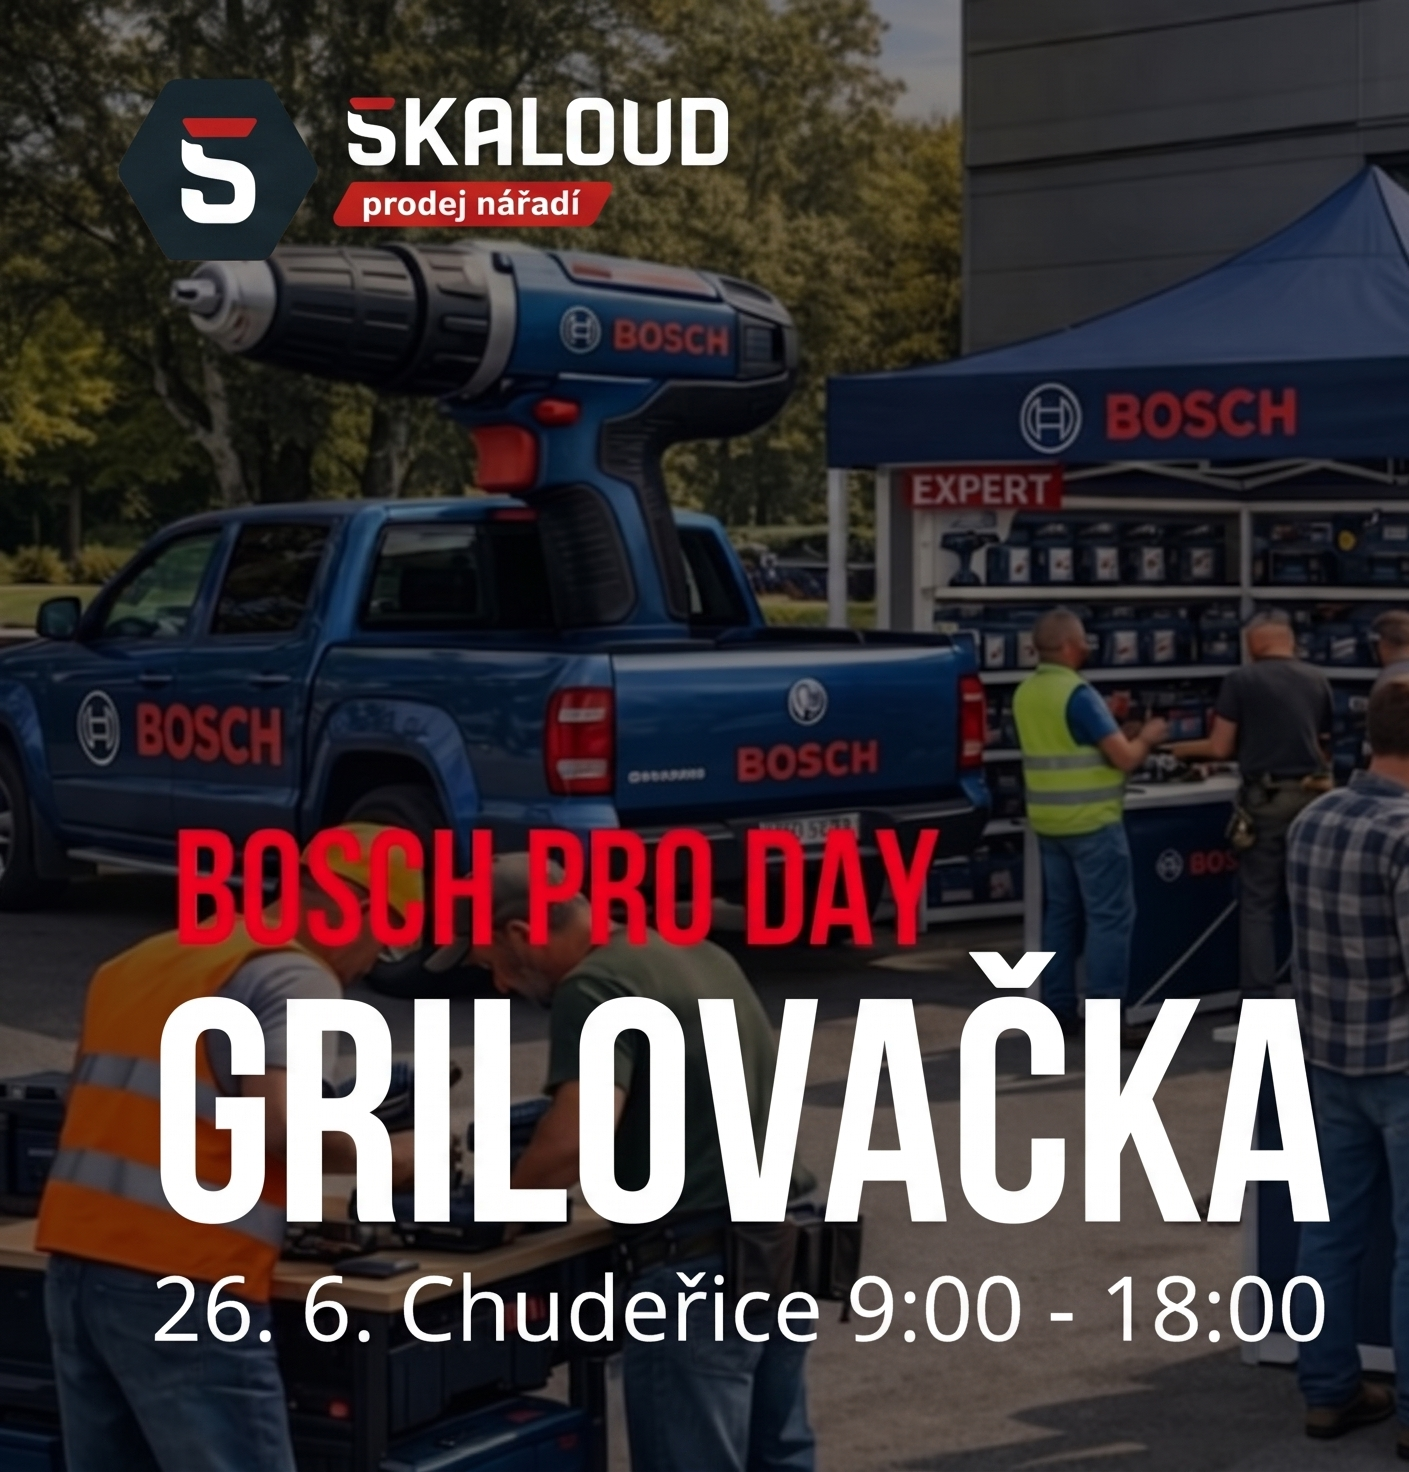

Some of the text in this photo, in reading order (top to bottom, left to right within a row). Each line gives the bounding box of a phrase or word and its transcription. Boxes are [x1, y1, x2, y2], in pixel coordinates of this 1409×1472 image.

[612, 318, 730, 356] BOSCH
[1105, 388, 1298, 441] BOSCH
[911, 473, 1053, 507] EXPERT
[136, 702, 284, 766] BOSCH
[736, 740, 881, 783] BOSCH
[1189, 850, 1239, 876] BOS
